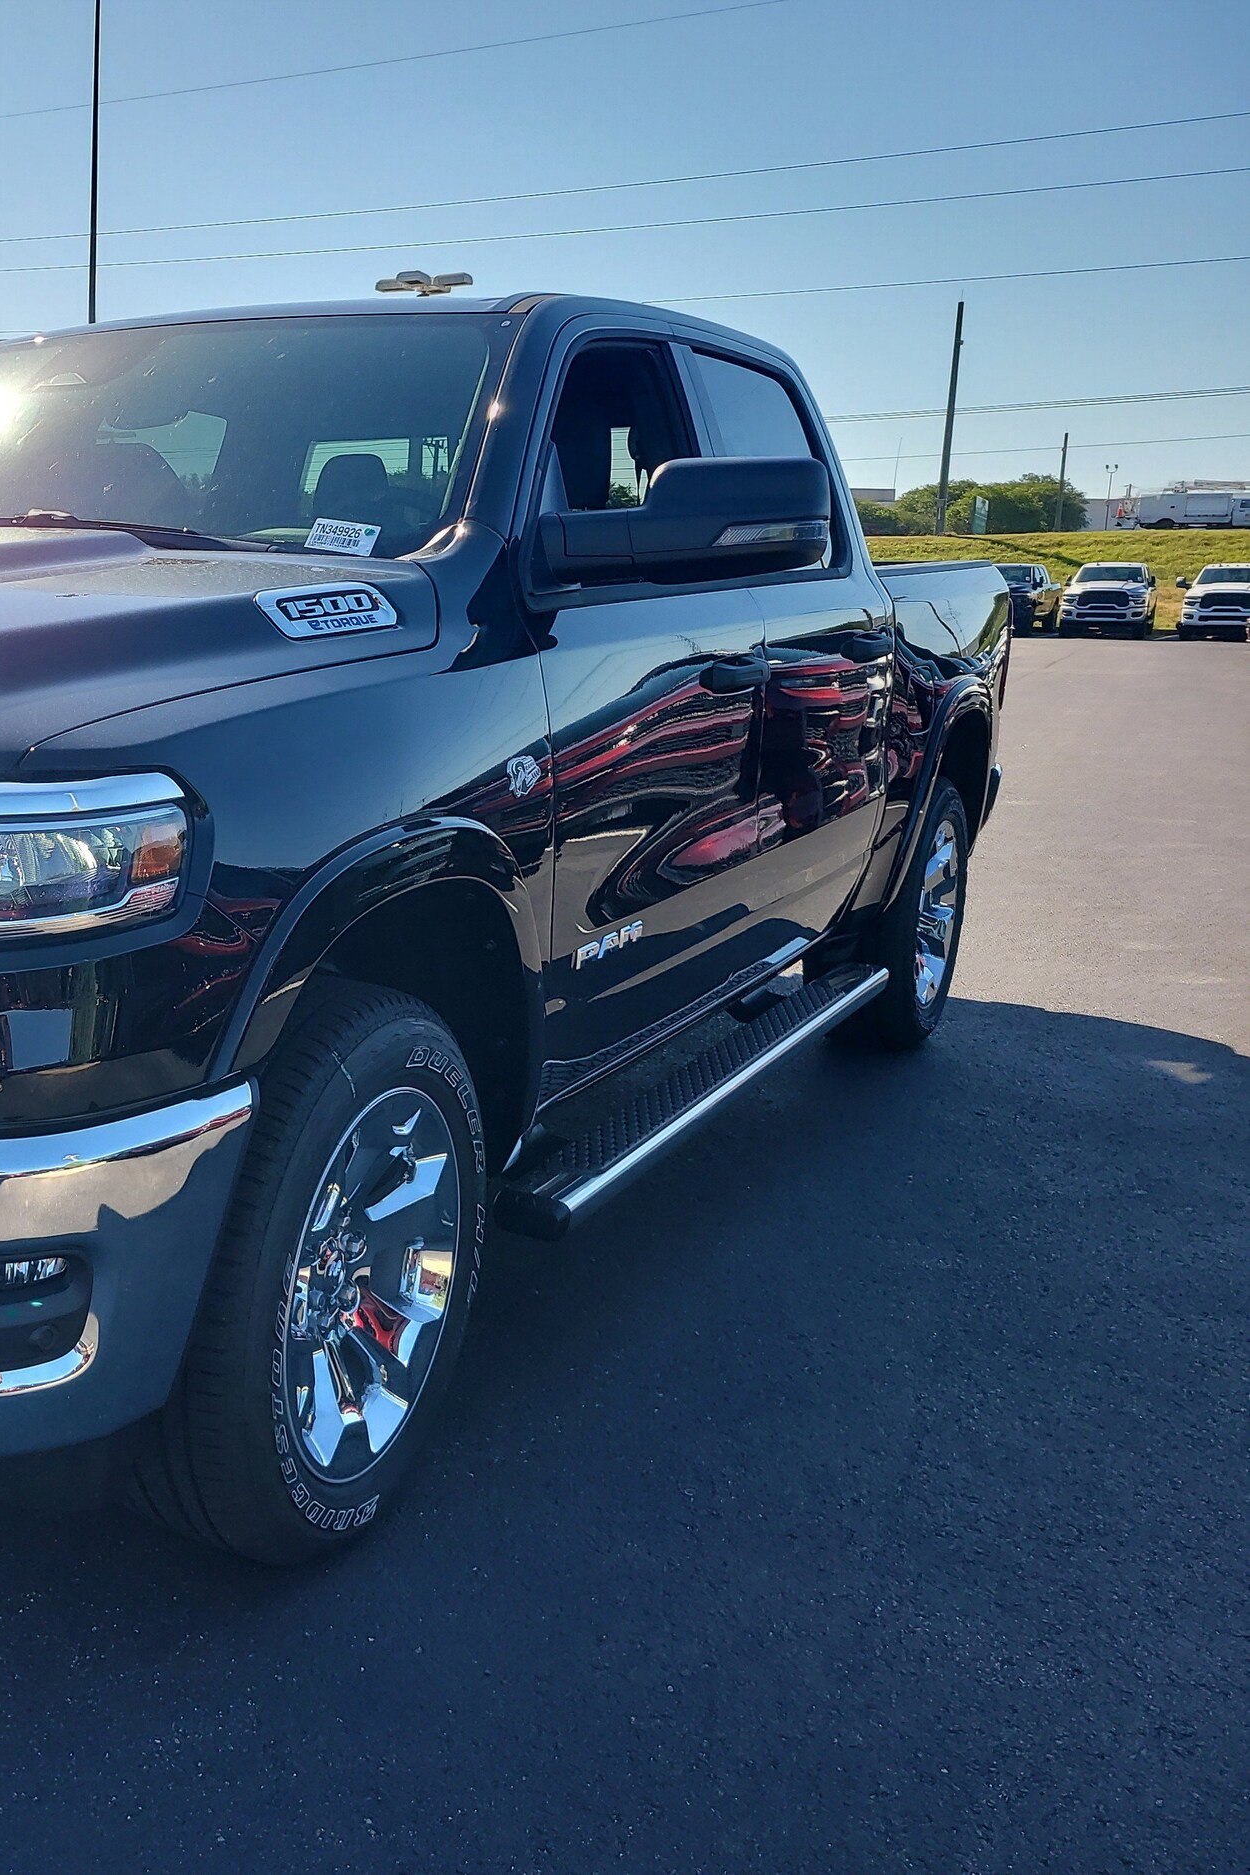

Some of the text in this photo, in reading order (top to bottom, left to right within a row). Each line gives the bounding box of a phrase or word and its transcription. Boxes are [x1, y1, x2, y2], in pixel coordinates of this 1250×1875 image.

[315, 523, 362, 538] TN349926
[280, 593, 372, 618] 1500
[406, 1046, 487, 1173] DUELER
[271, 1252, 380, 1532] BRIDGESTONE
